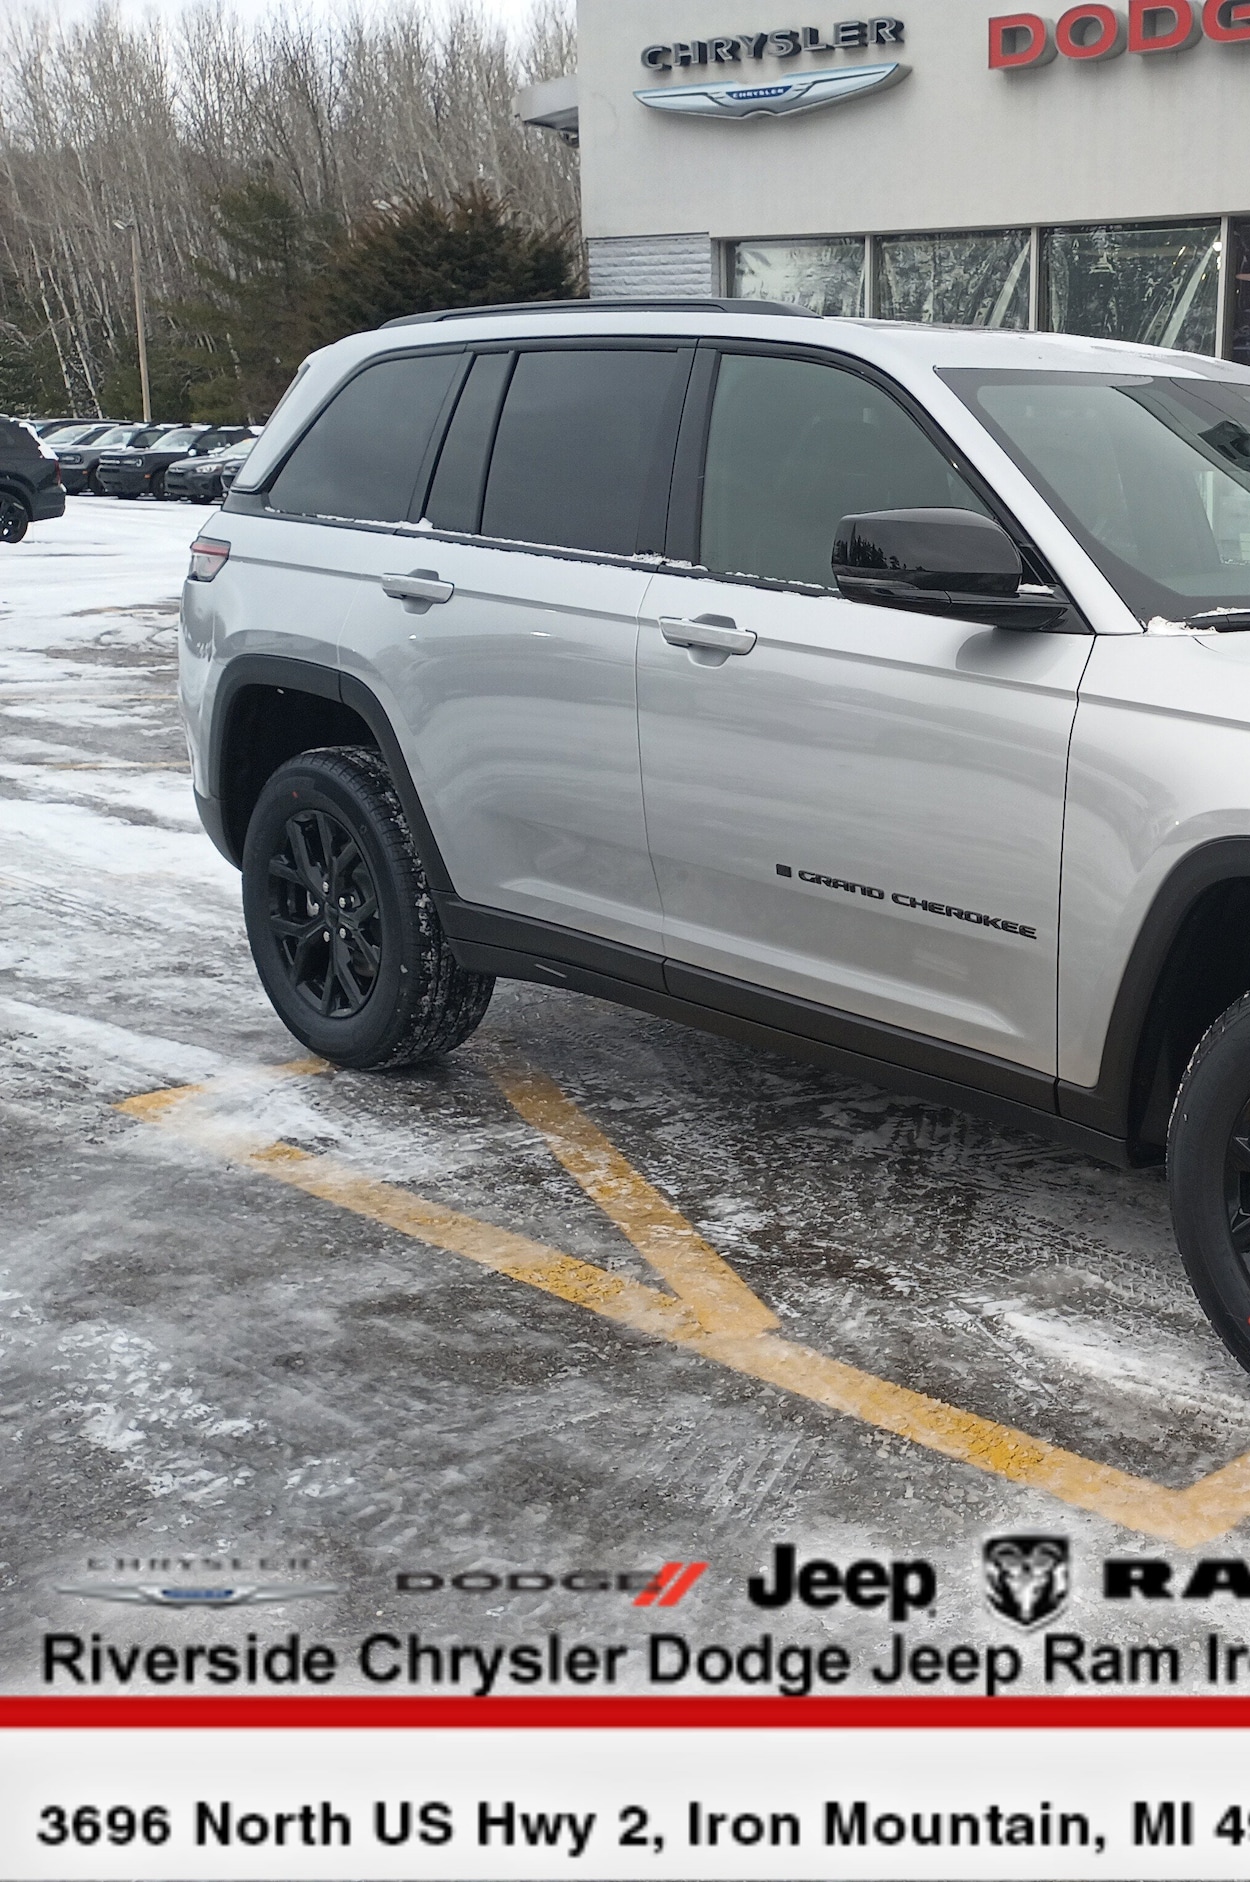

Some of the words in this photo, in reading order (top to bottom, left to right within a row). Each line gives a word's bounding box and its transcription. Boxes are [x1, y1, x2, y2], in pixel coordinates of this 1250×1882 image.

[641, 16, 905, 71] CHRYSLER
[798, 870, 884, 900] GRAND
[891, 893, 1038, 940] CHEROKEE
